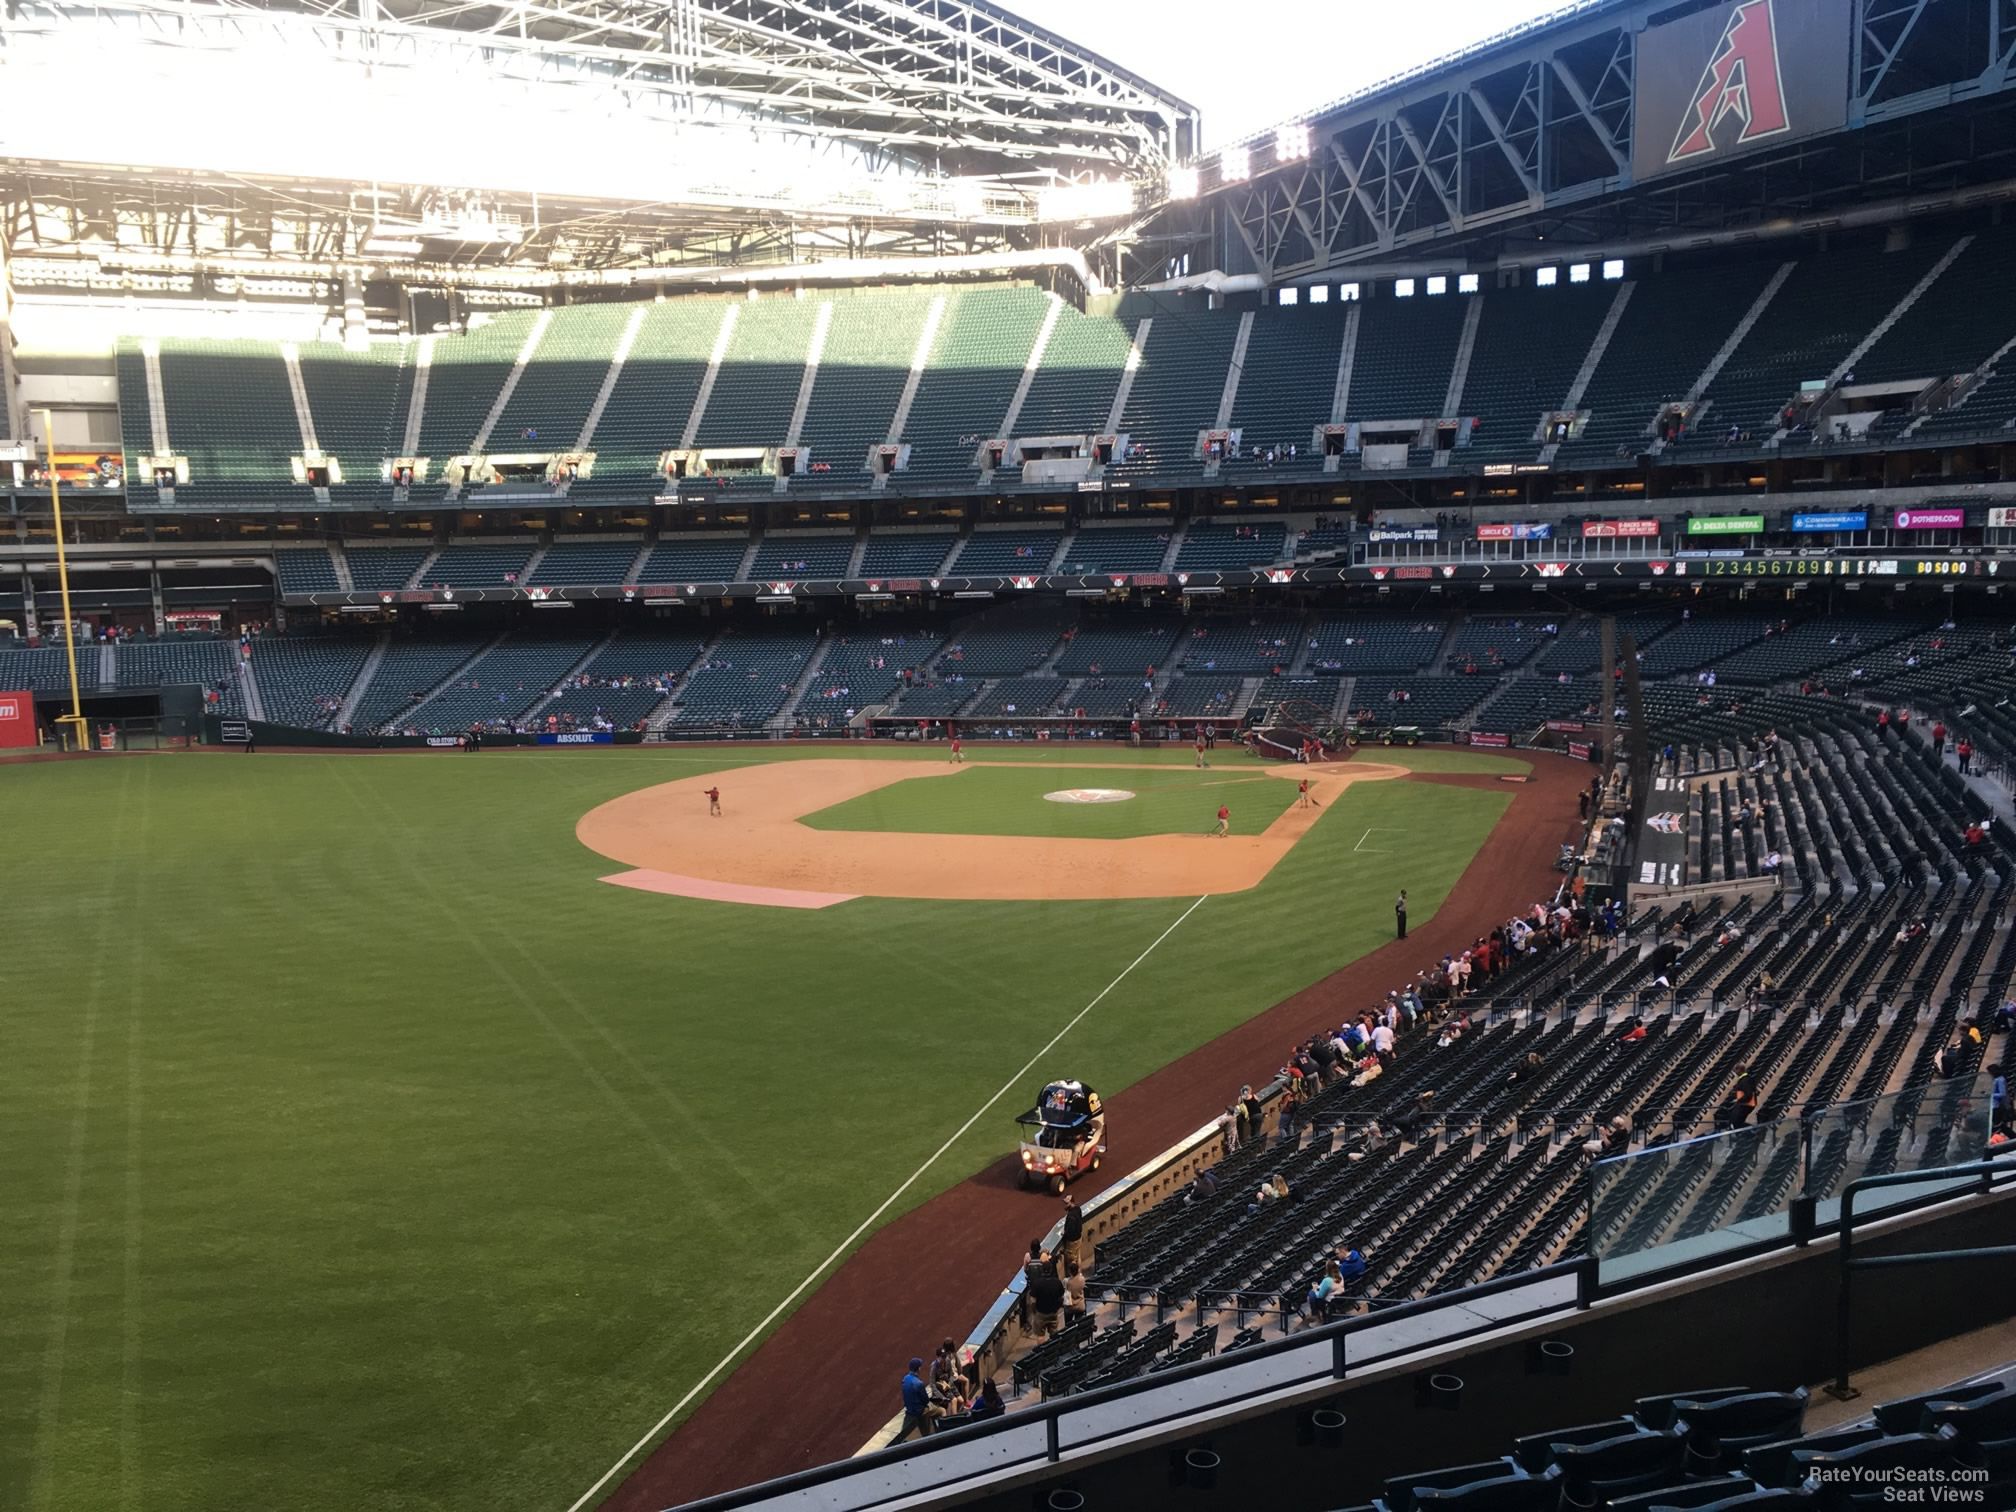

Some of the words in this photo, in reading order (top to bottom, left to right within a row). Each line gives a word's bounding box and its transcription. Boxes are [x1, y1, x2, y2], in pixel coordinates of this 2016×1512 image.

[1805, 515, 1864, 524] COMMONWEALTH
[1728, 520, 1759, 529] DENTAL
[1381, 531, 1413, 541] Ballpark
[1480, 528, 1501, 536] CIRCLE
[1705, 561, 1710, 574] 1
[1716, 561, 1725, 574] 2
[1730, 561, 1739, 574] 3
[1743, 561, 1752, 574] 4
[1757, 561, 1766, 574] 5
[1771, 561, 1780, 574] 6
[1785, 561, 1793, 574] 7
[1797, 561, 1806, 574] 8
[1810, 561, 1819, 574] 9
[426, 737, 441, 745] COLD
[441, 737, 458, 745] STONE
